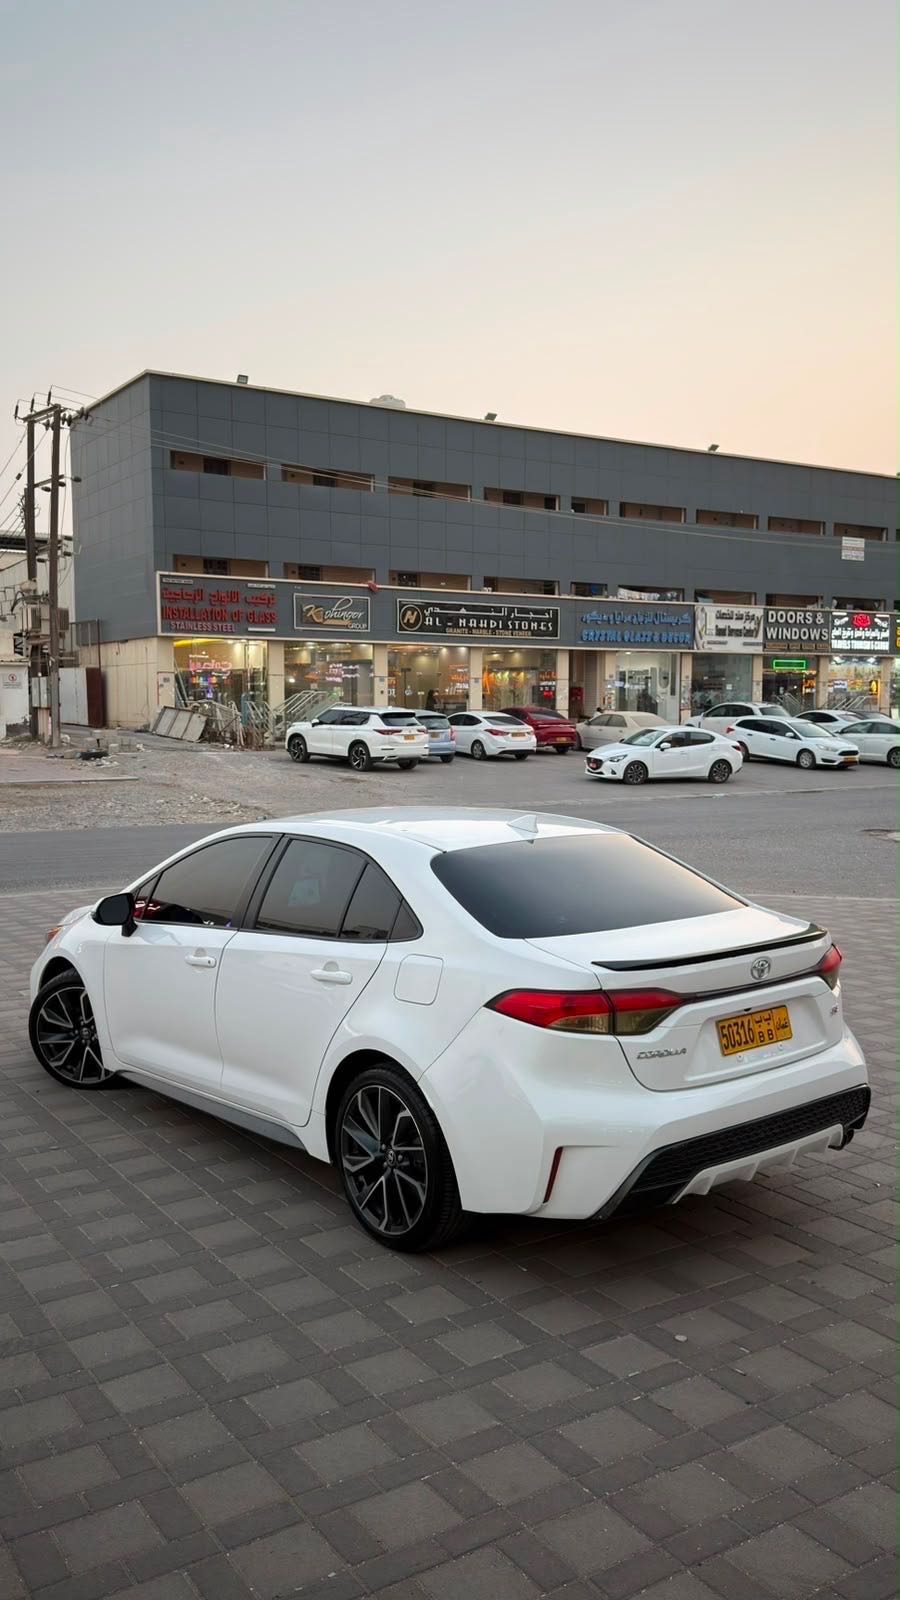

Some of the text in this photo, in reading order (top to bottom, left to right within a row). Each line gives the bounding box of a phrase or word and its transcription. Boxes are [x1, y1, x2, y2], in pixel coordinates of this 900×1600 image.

[162, 606, 278, 624] INSTALLATION OF GLASS
[768, 610, 824, 624] DOORS &
[170, 621, 236, 632] STAINLESS STEEL
[348, 622, 368, 630] GROUP
[424, 616, 441, 626] AL
[459, 618, 502, 629] NAHDI
[507, 620, 553, 631] STONES
[446, 627, 468, 635] GRANITE
[582, 628, 622, 642] CRYSTAL
[766, 627, 829, 640] WINDOWS
[720, 1019, 755, 1050] 50316
[636, 1047, 687, 1060] COROLLA
